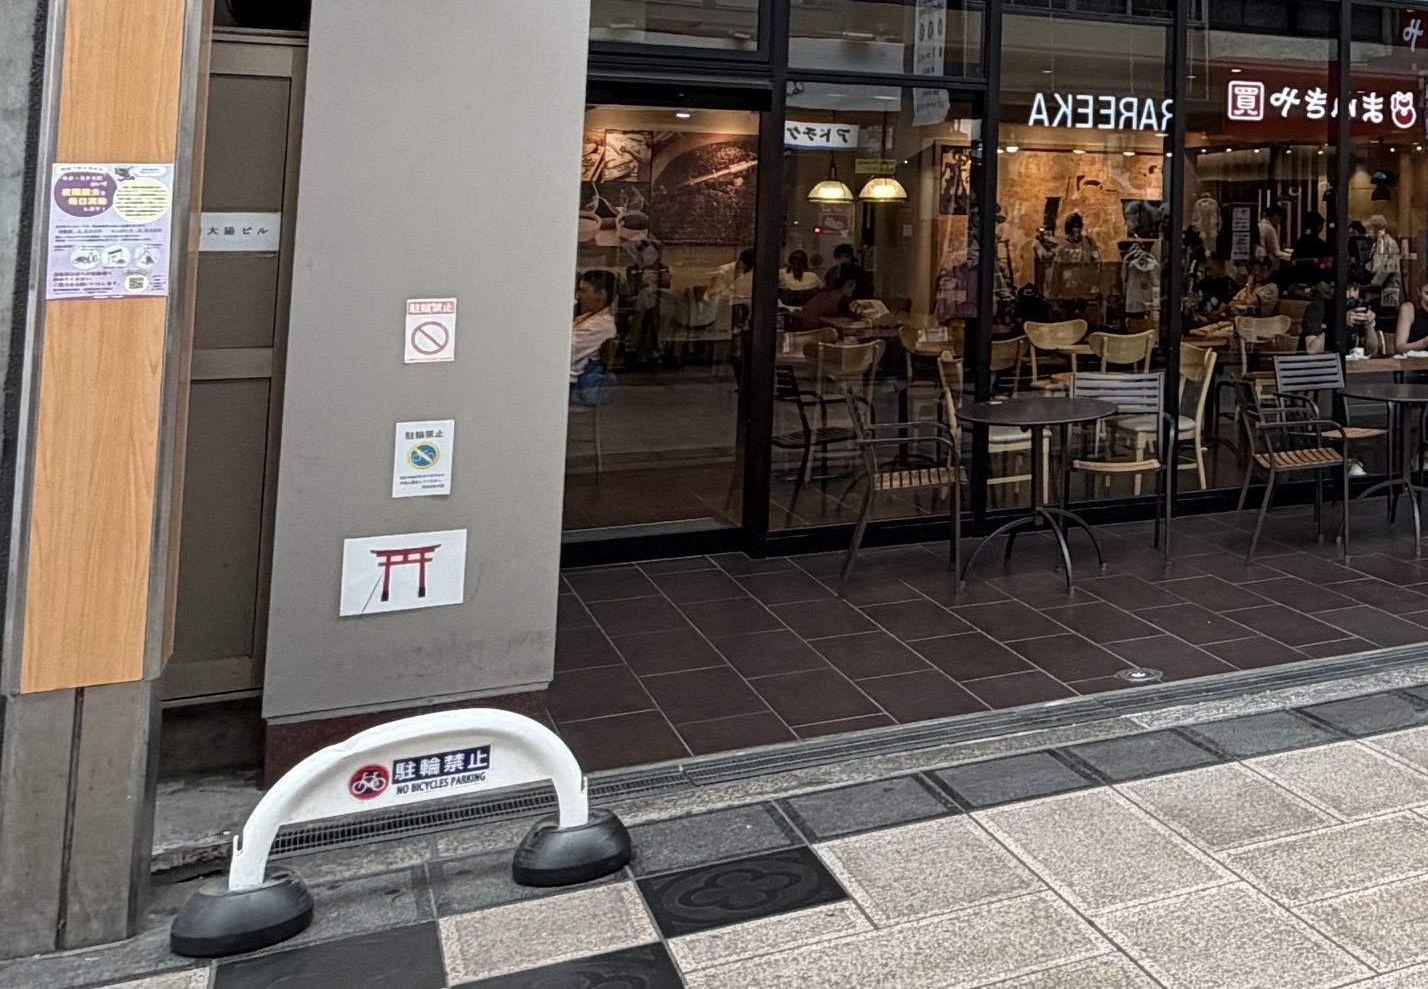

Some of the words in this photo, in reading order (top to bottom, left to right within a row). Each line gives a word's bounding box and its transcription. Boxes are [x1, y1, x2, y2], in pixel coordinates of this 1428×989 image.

[394, 750, 488, 780] 駐輪禁止
[396, 784, 409, 795] NO
[411, 779, 449, 793] BICYCLES
[450, 771, 486, 786] PARKING
